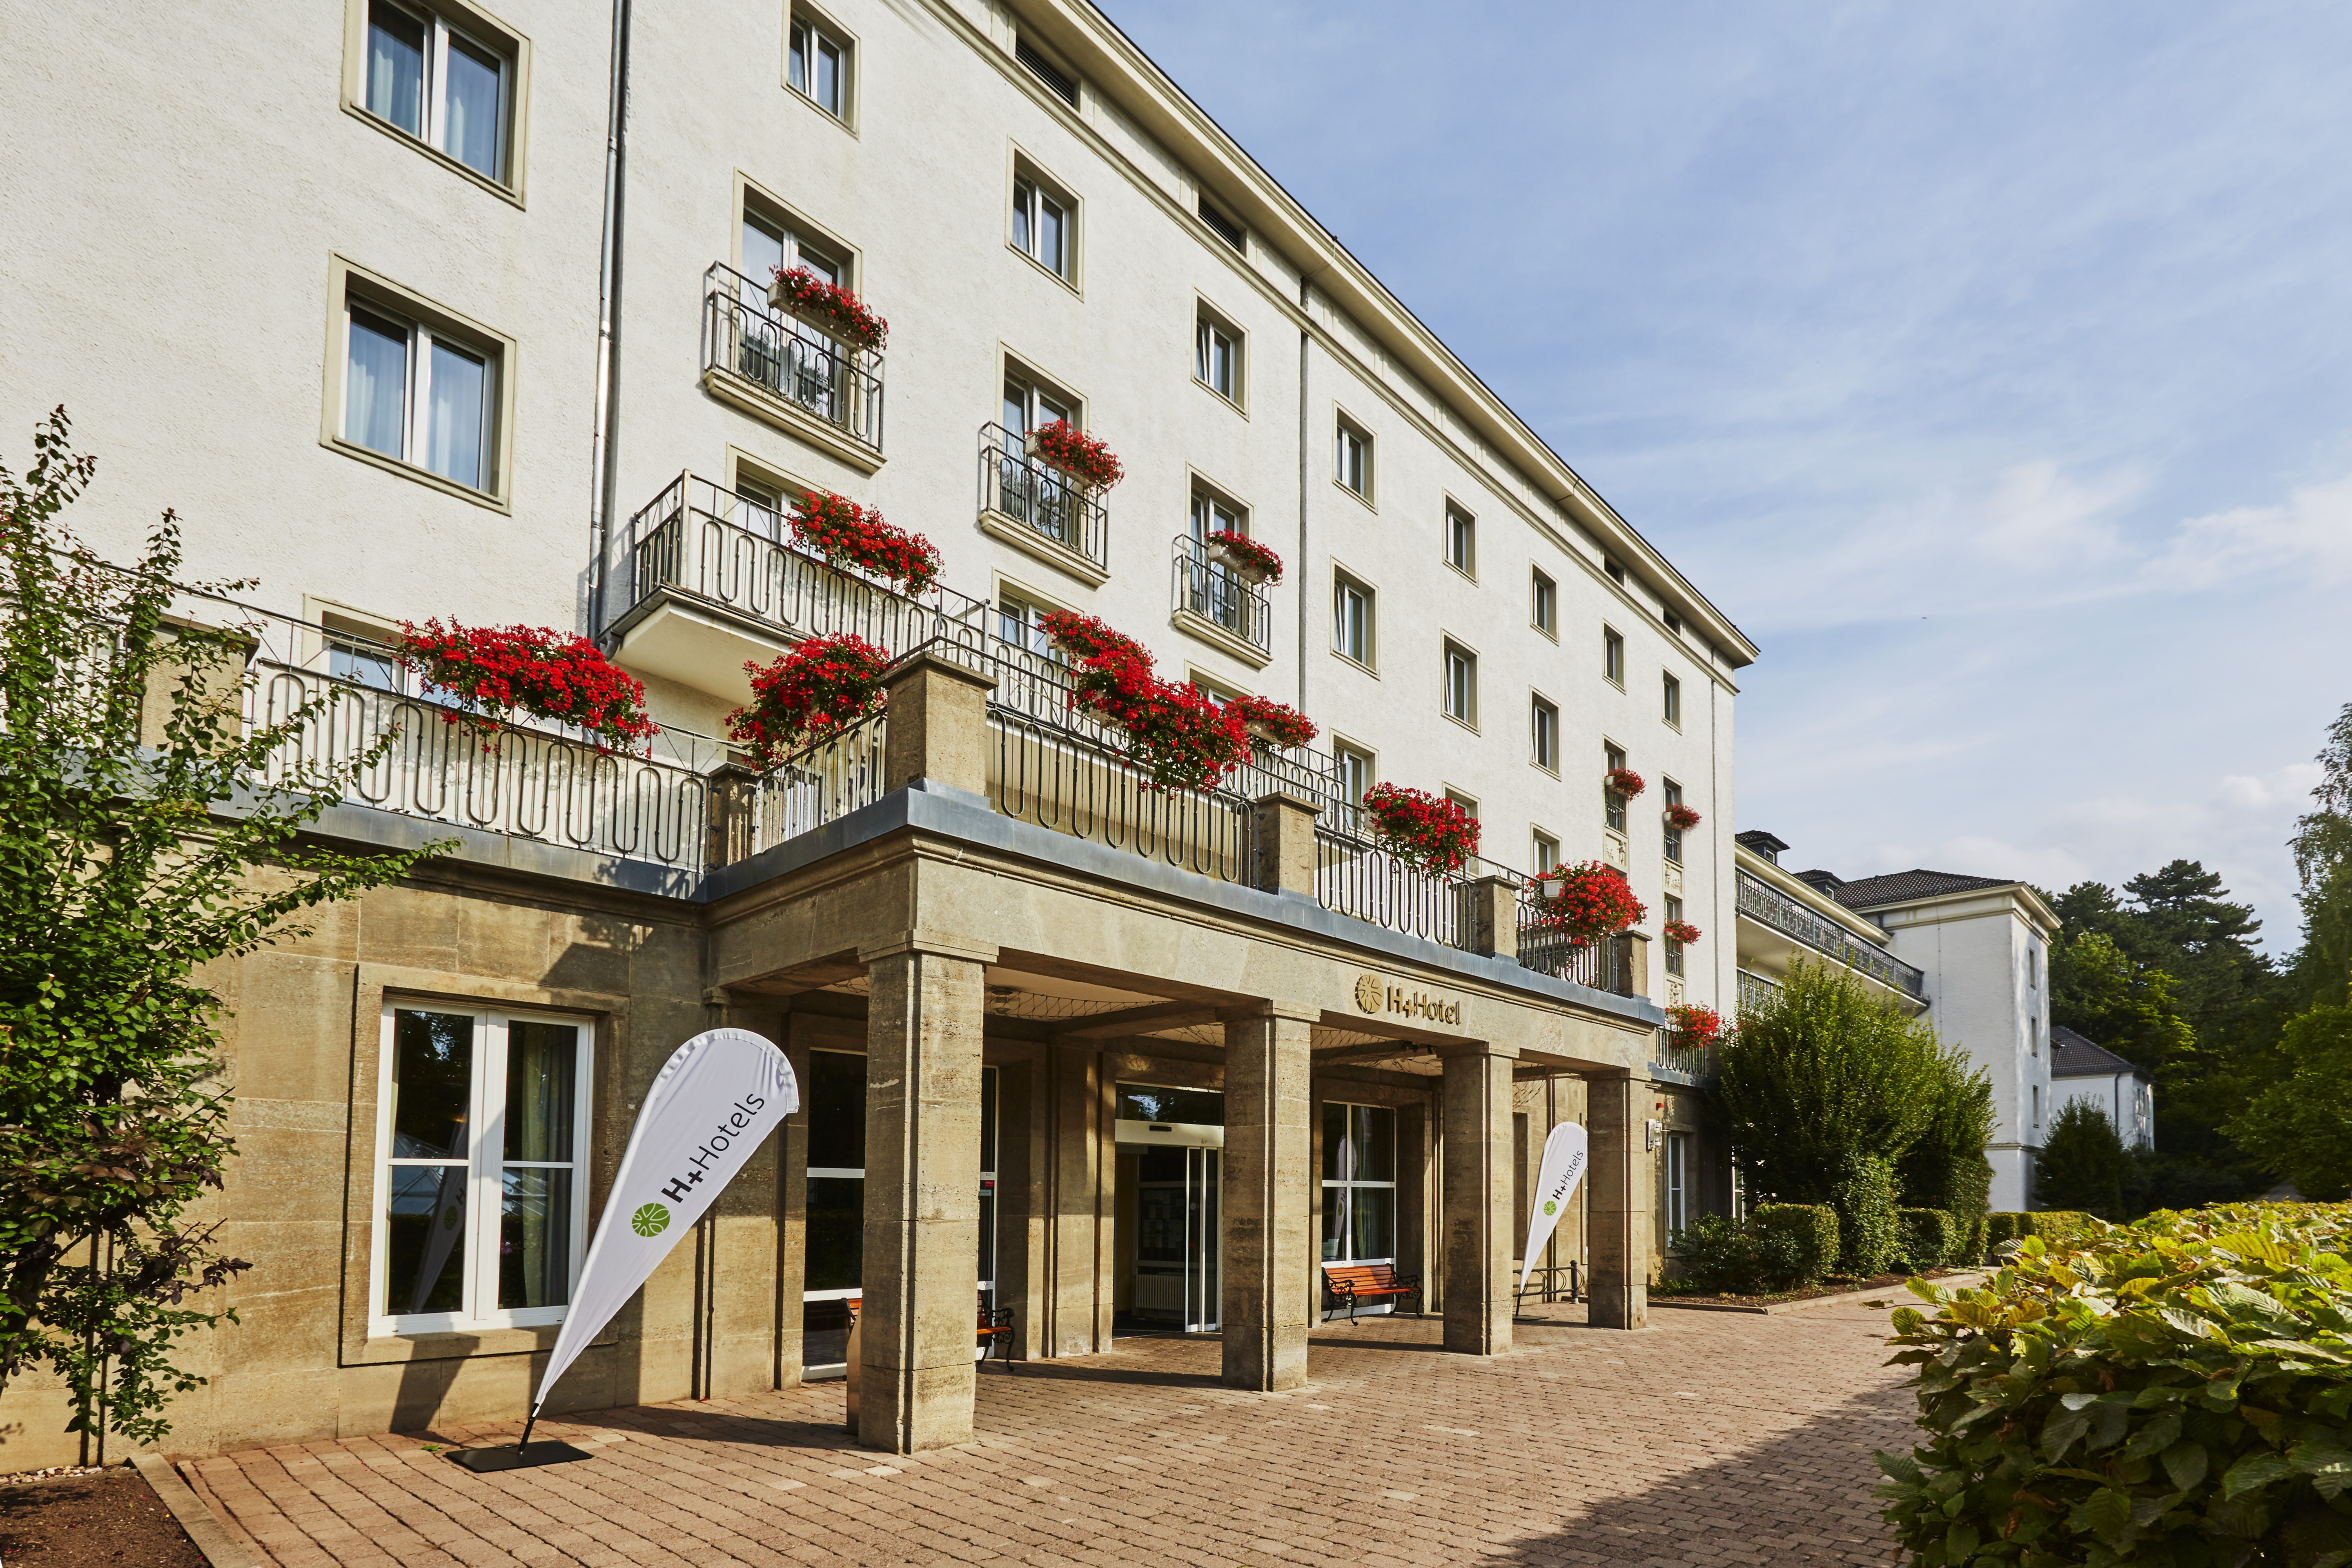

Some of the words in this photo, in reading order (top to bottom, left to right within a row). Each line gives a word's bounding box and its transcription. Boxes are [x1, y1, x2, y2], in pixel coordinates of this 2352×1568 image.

[1388, 985, 1461, 1025] H+Hotel
[661, 1094, 764, 1203] H+Hotels
[1552, 1150, 1584, 1200] H+Hotels
